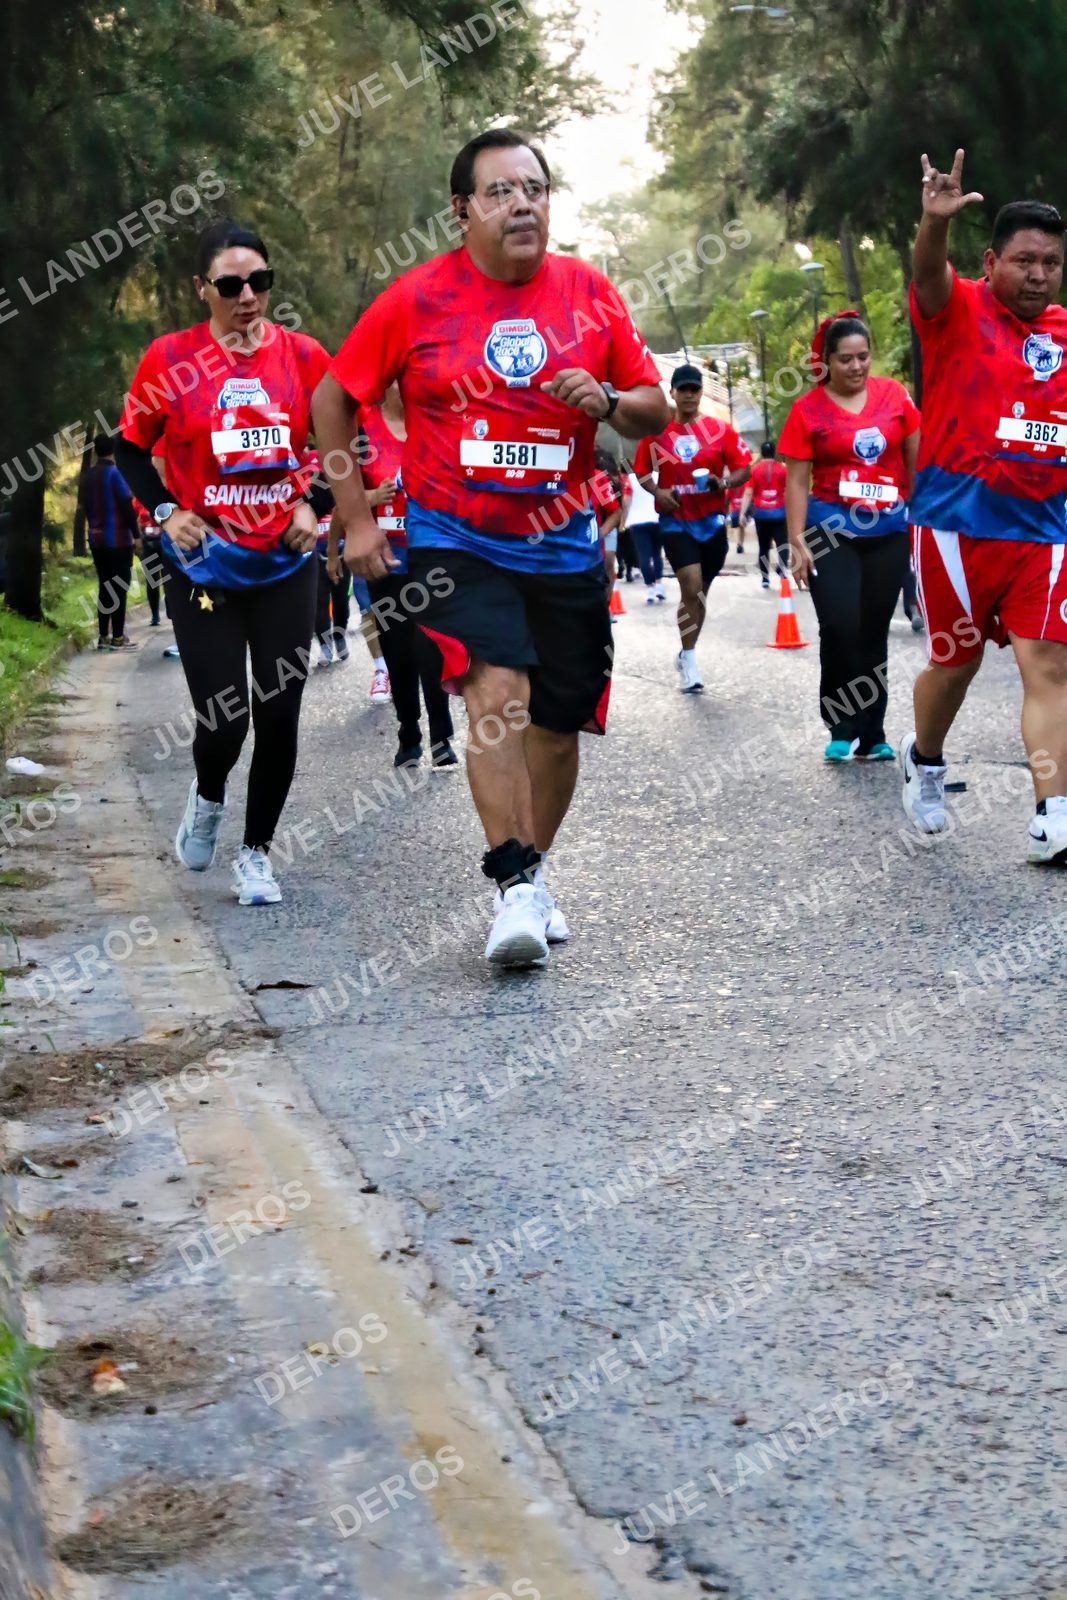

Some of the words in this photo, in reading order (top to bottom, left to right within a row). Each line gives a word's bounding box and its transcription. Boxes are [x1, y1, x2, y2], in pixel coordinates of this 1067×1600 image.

[499, 325, 530, 333] BIMBO
[500, 335, 531, 347] Global
[494, 346, 520, 356] Race
[241, 427, 281, 449] 3370
[1025, 422, 1058, 443] 3362
[493, 443, 537, 466] 3581
[204, 483, 293, 506] SANTIAGO
[860, 484, 883, 498] 1370
